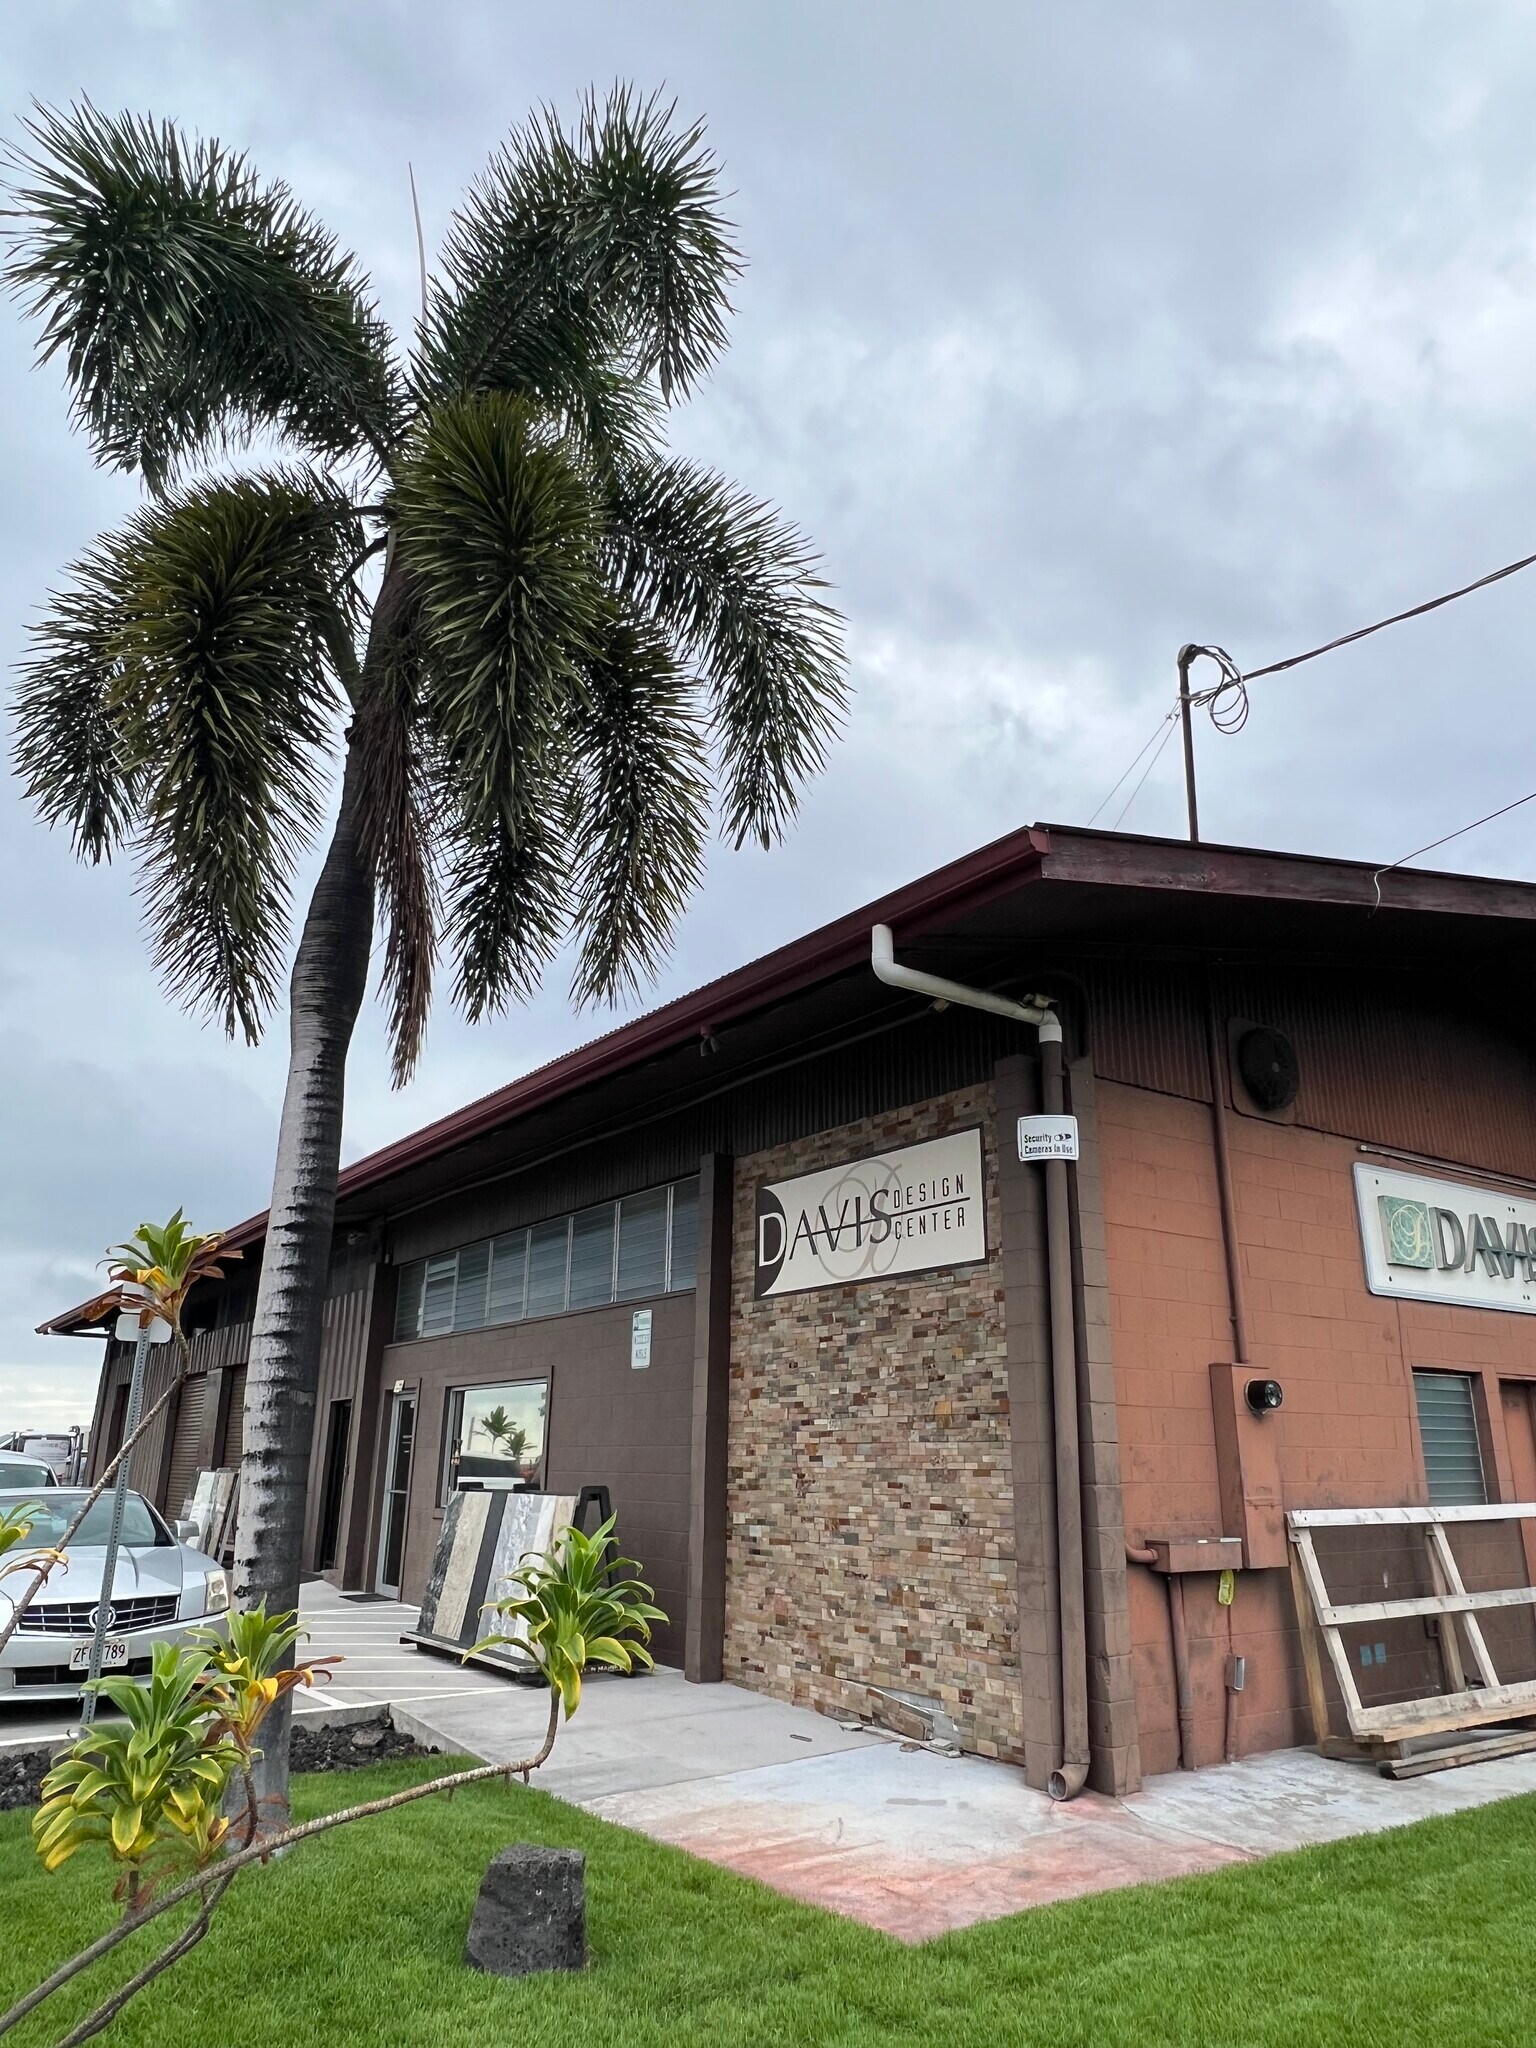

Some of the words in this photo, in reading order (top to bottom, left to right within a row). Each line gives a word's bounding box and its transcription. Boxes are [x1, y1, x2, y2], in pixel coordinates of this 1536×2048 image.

[1024, 1133, 1052, 1143] Security
[1024, 1145, 1052, 1154] Cameras
[1053, 1144, 1061, 1153] In
[1062, 1144, 1073, 1154] Use
[893, 1174, 964, 1209] DESIGN
[758, 1188, 892, 1267] DAVIS
[895, 1207, 965, 1240] CENTER
[73, 1647, 92, 1663] ZF
[104, 1644, 126, 1660] 789
